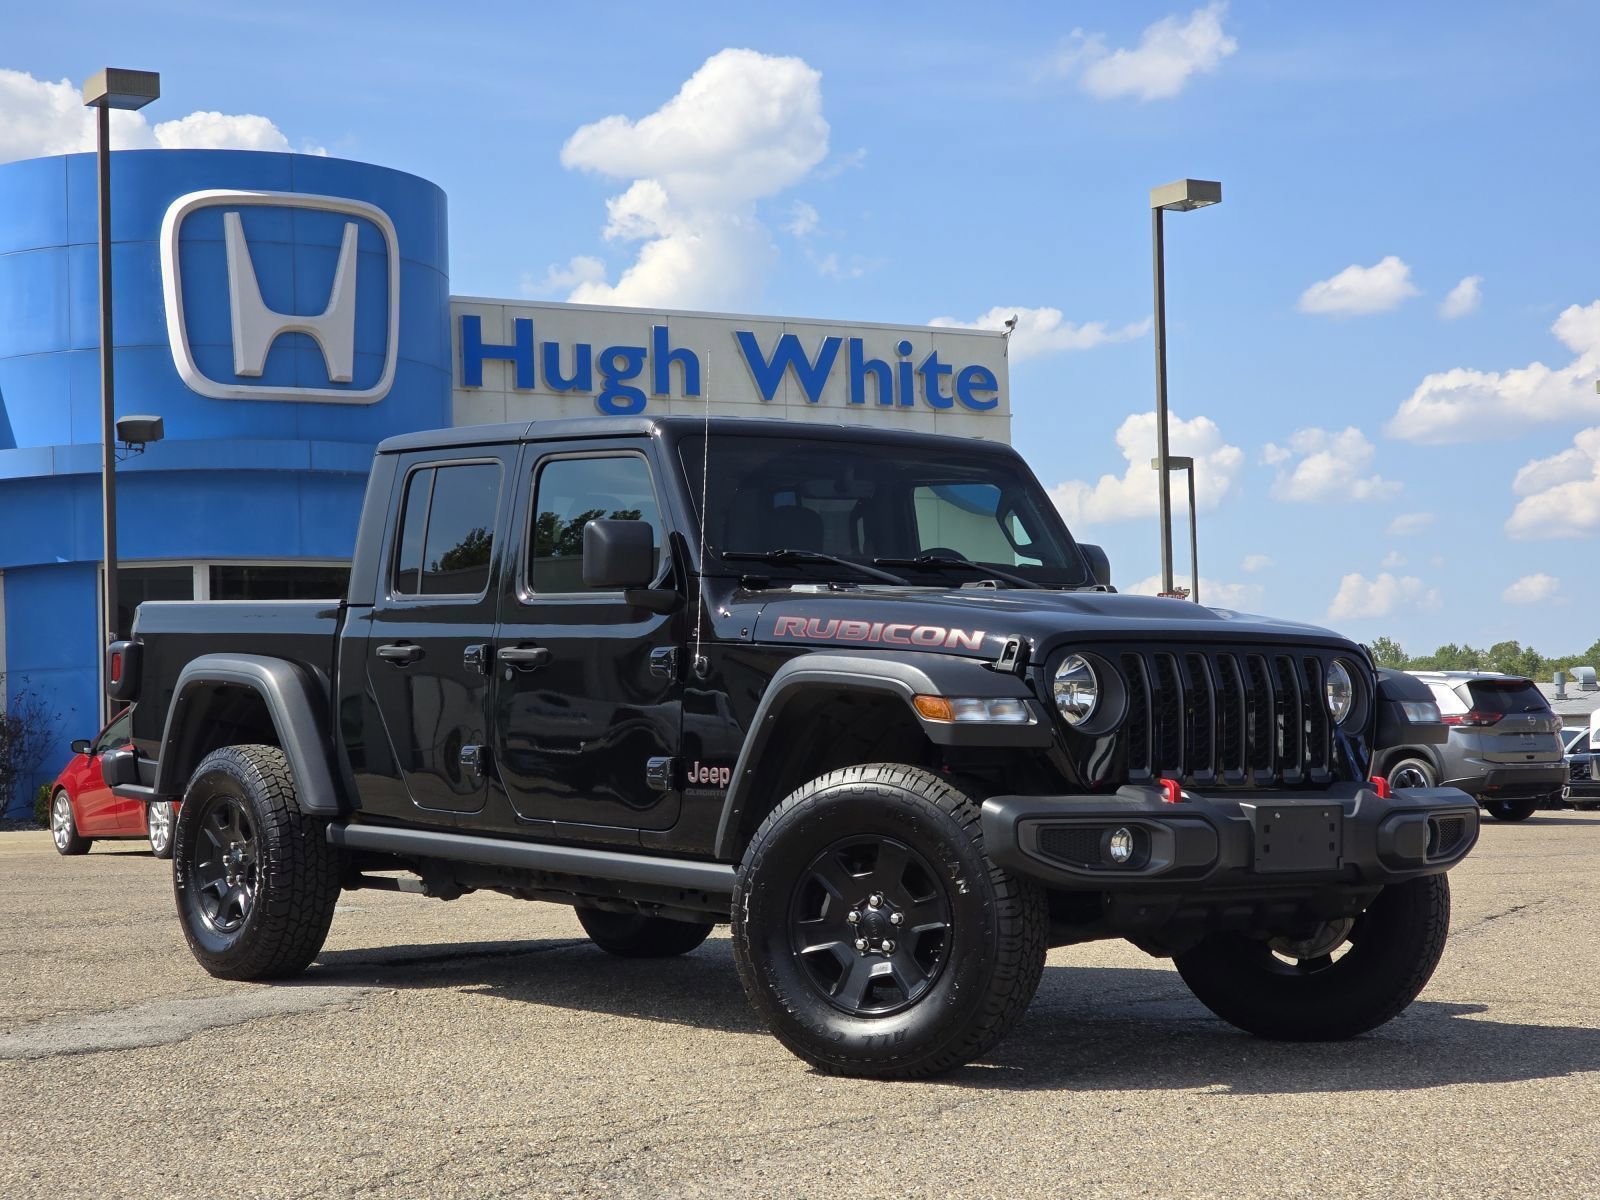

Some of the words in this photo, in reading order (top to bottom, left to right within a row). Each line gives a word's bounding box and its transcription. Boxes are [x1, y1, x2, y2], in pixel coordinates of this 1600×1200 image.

[458, 315, 700, 415] Hugh
[736, 330, 999, 411] White
[774, 616, 985, 650] RUBICON
[687, 761, 730, 789] Jeep
